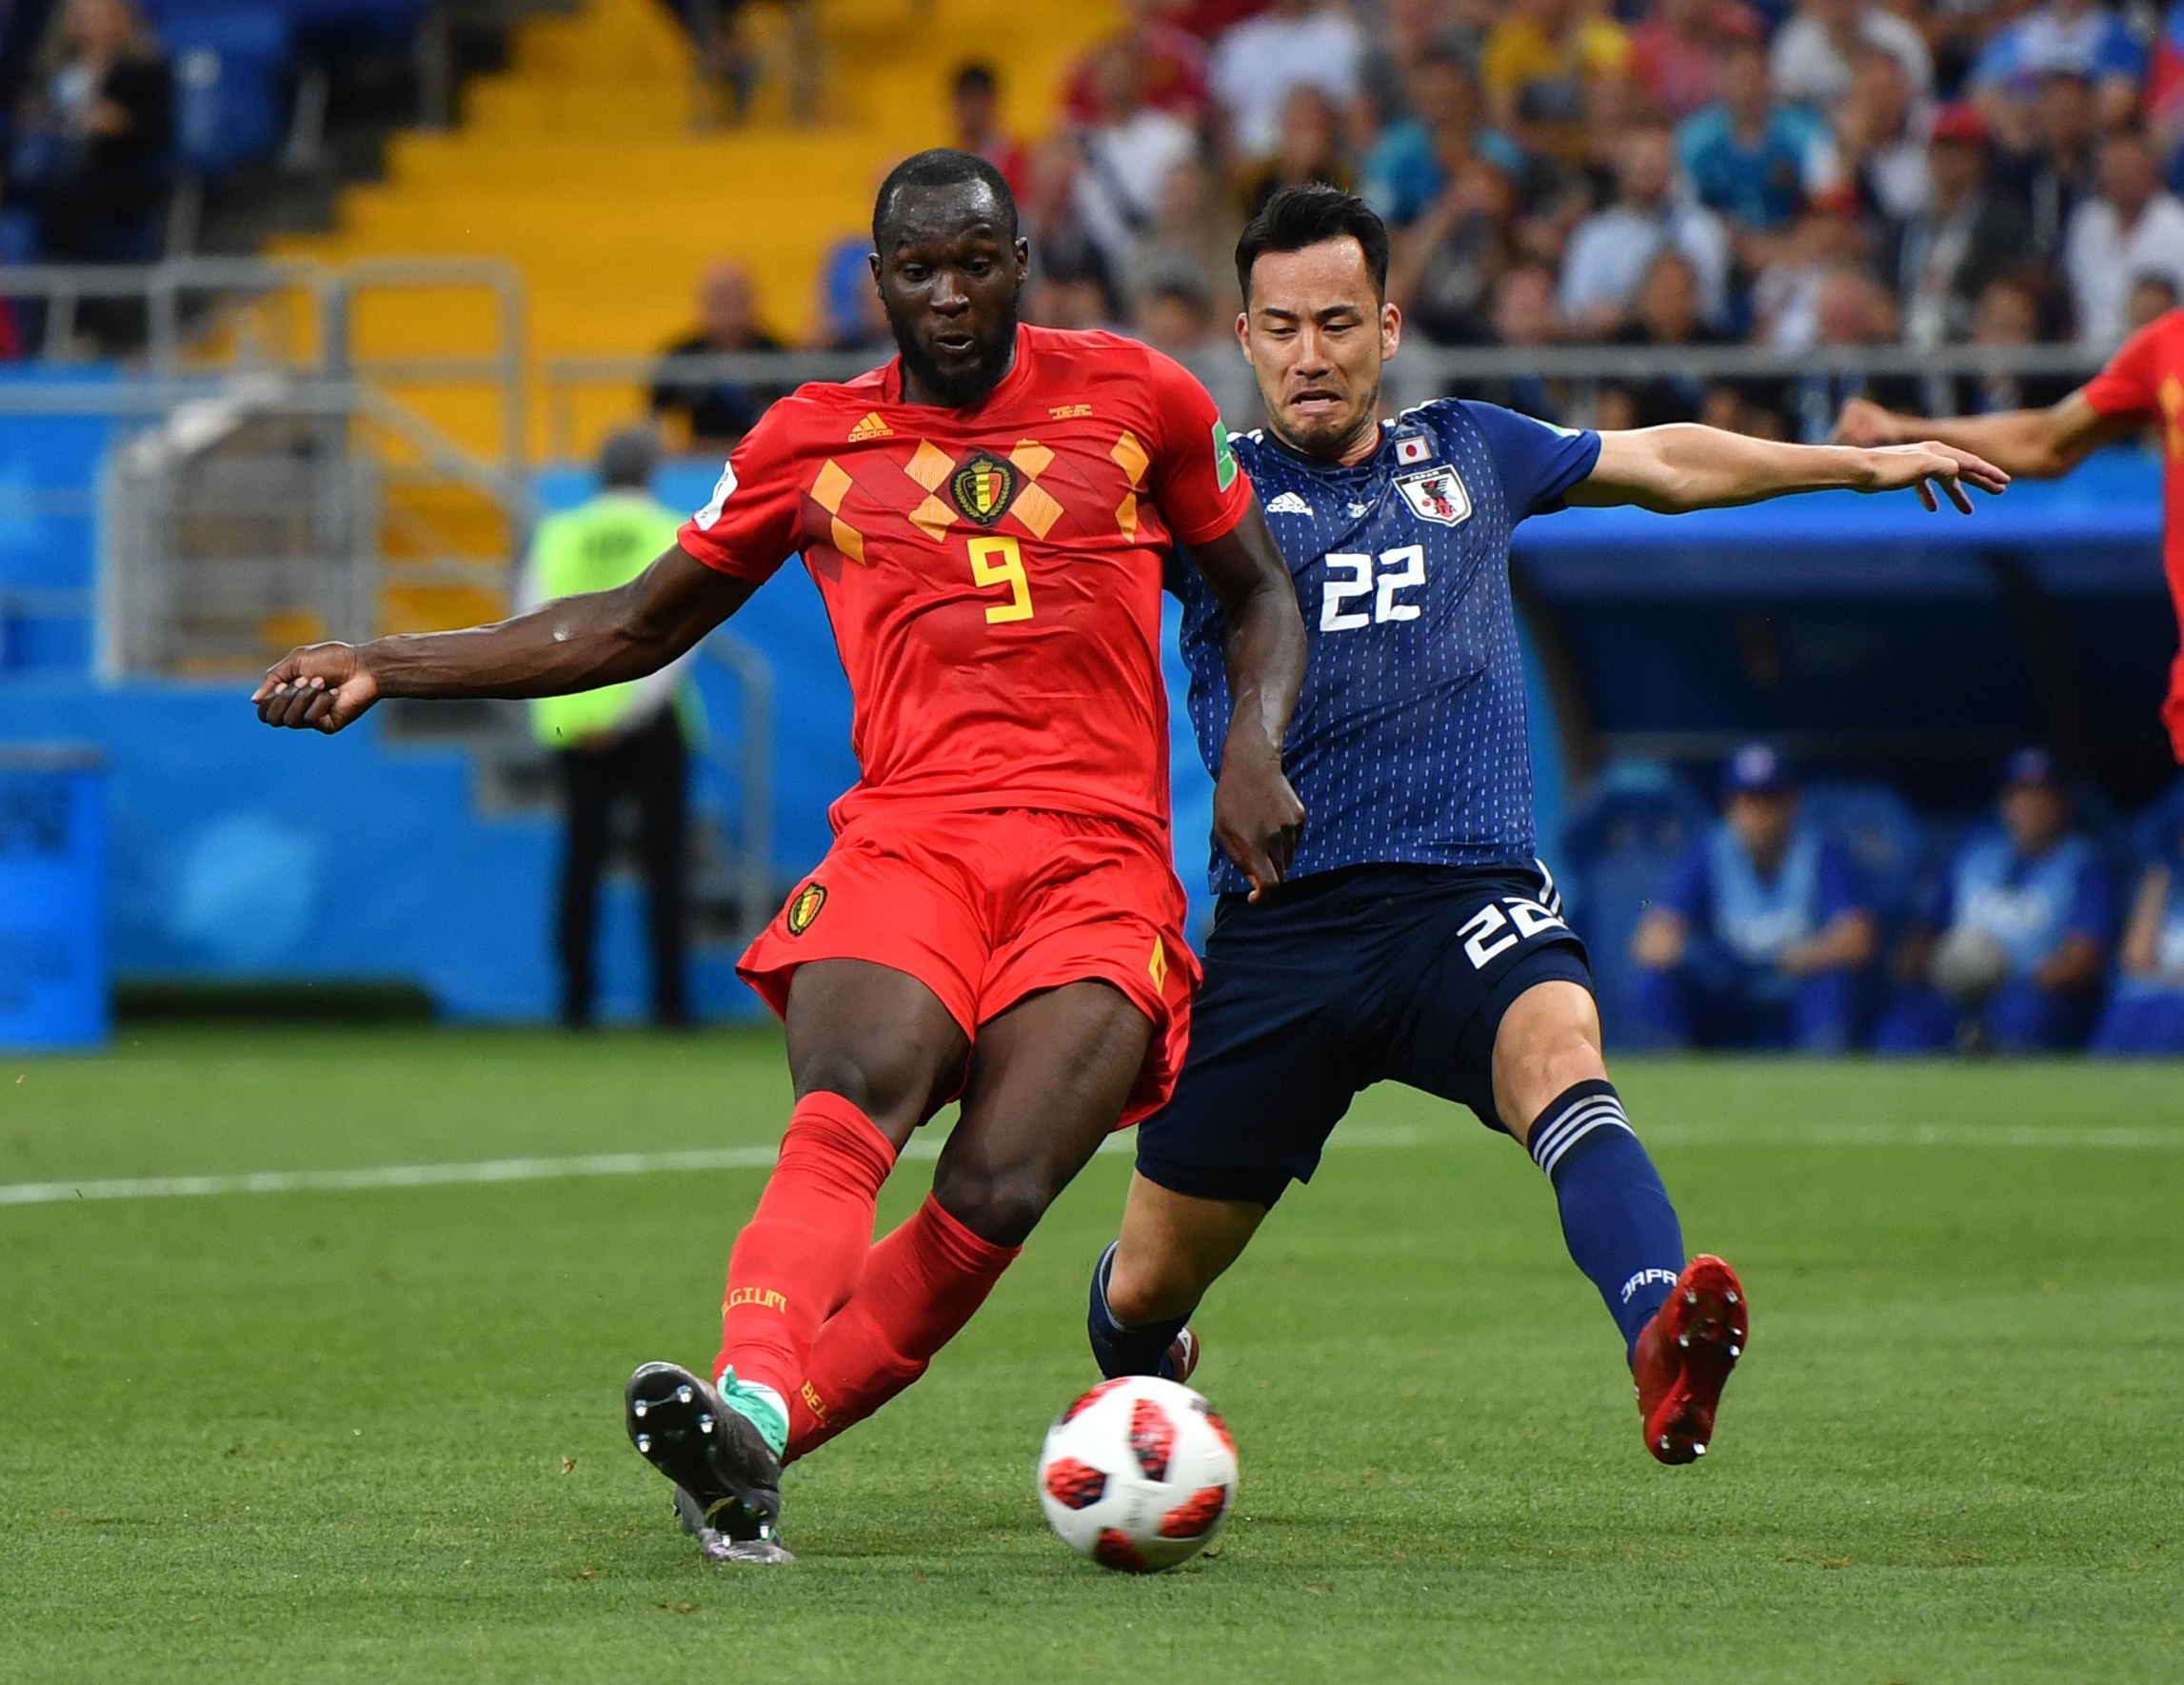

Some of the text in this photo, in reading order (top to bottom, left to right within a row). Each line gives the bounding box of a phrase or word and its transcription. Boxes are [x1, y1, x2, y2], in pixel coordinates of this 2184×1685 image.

[967, 536, 1034, 624] 9
[1320, 545, 1426, 631] 22
[1456, 897, 1569, 969] 22
[721, 1287, 786, 1320] LGIUM
[1620, 1268, 1680, 1304] JAPA
[801, 1379, 830, 1423] BEL
